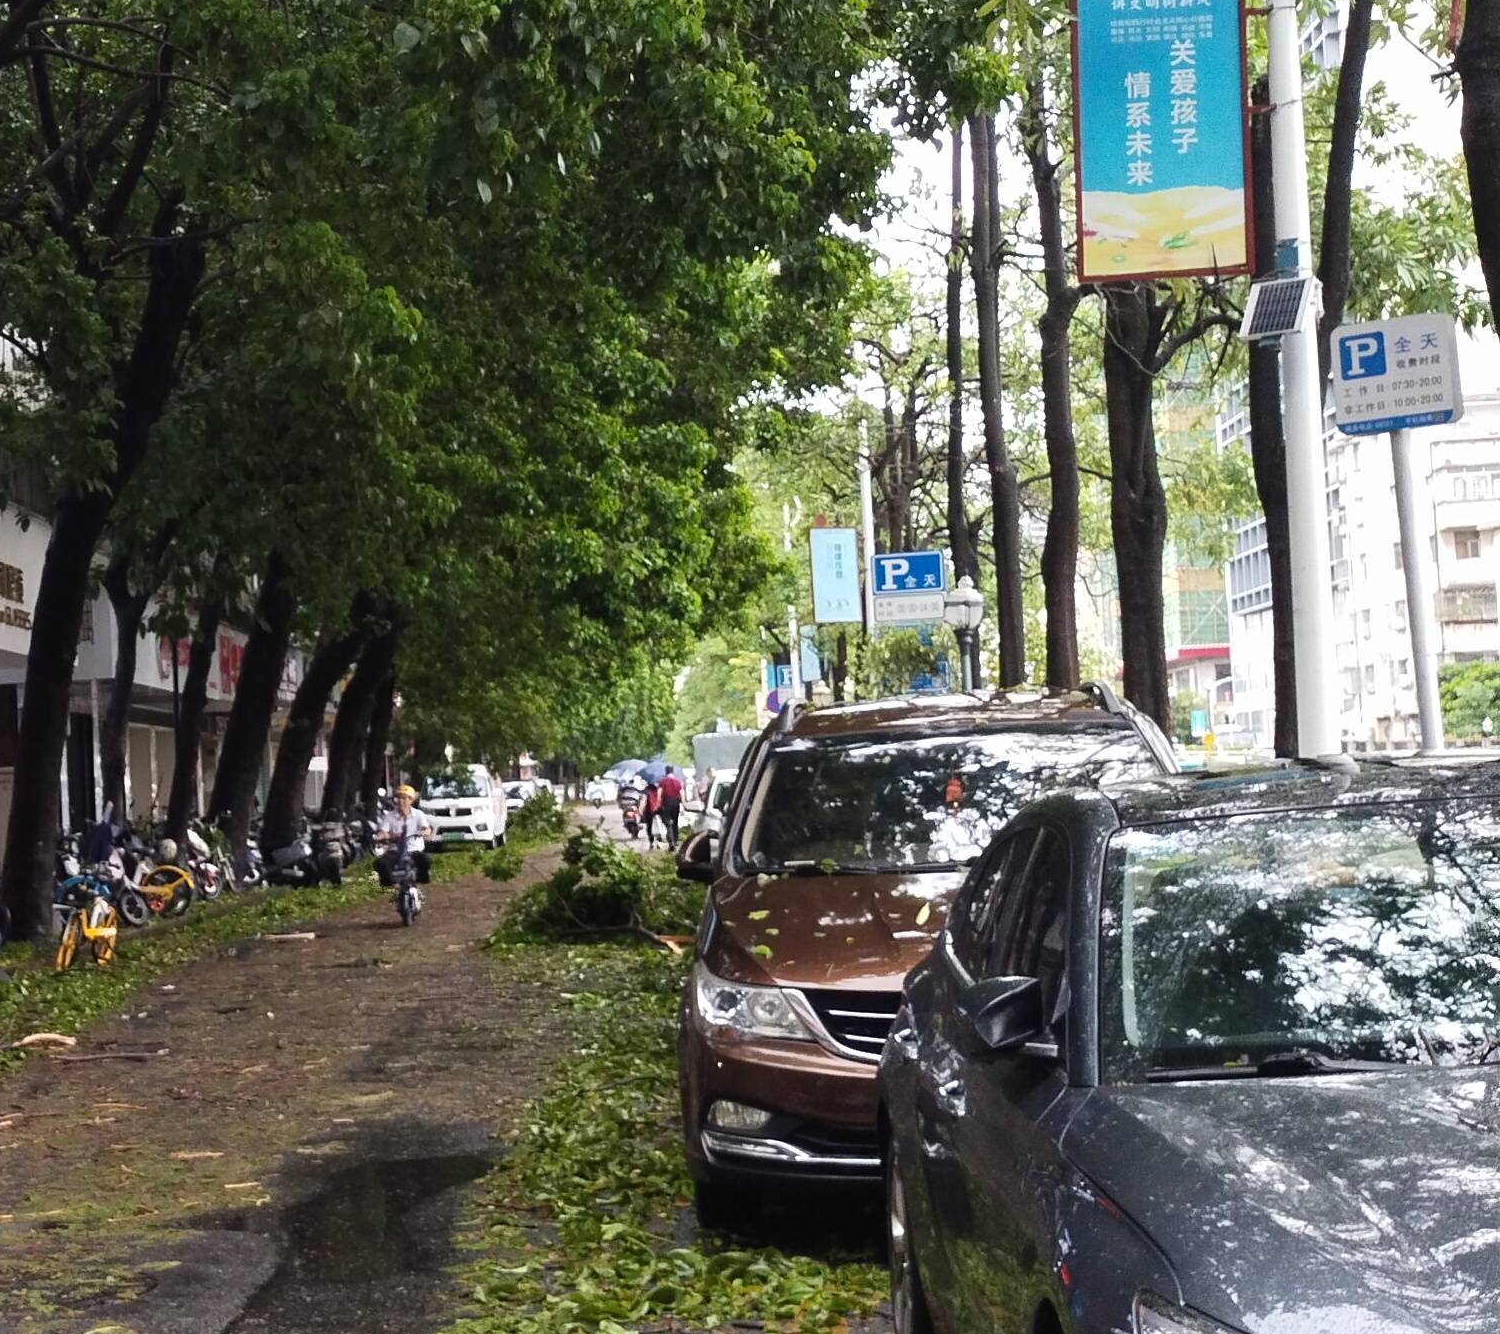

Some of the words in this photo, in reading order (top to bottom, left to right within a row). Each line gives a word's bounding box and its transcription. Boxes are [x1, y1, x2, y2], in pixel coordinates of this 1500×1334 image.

[1170, 39, 1198, 155] 关爱孩子
[1124, 71, 1153, 186] 情系未来
[1345, 337, 1378, 376] P
[1394, 332, 1438, 353] 全天
[880, 558, 910, 590] P
[904, 573, 937, 589] 全天
